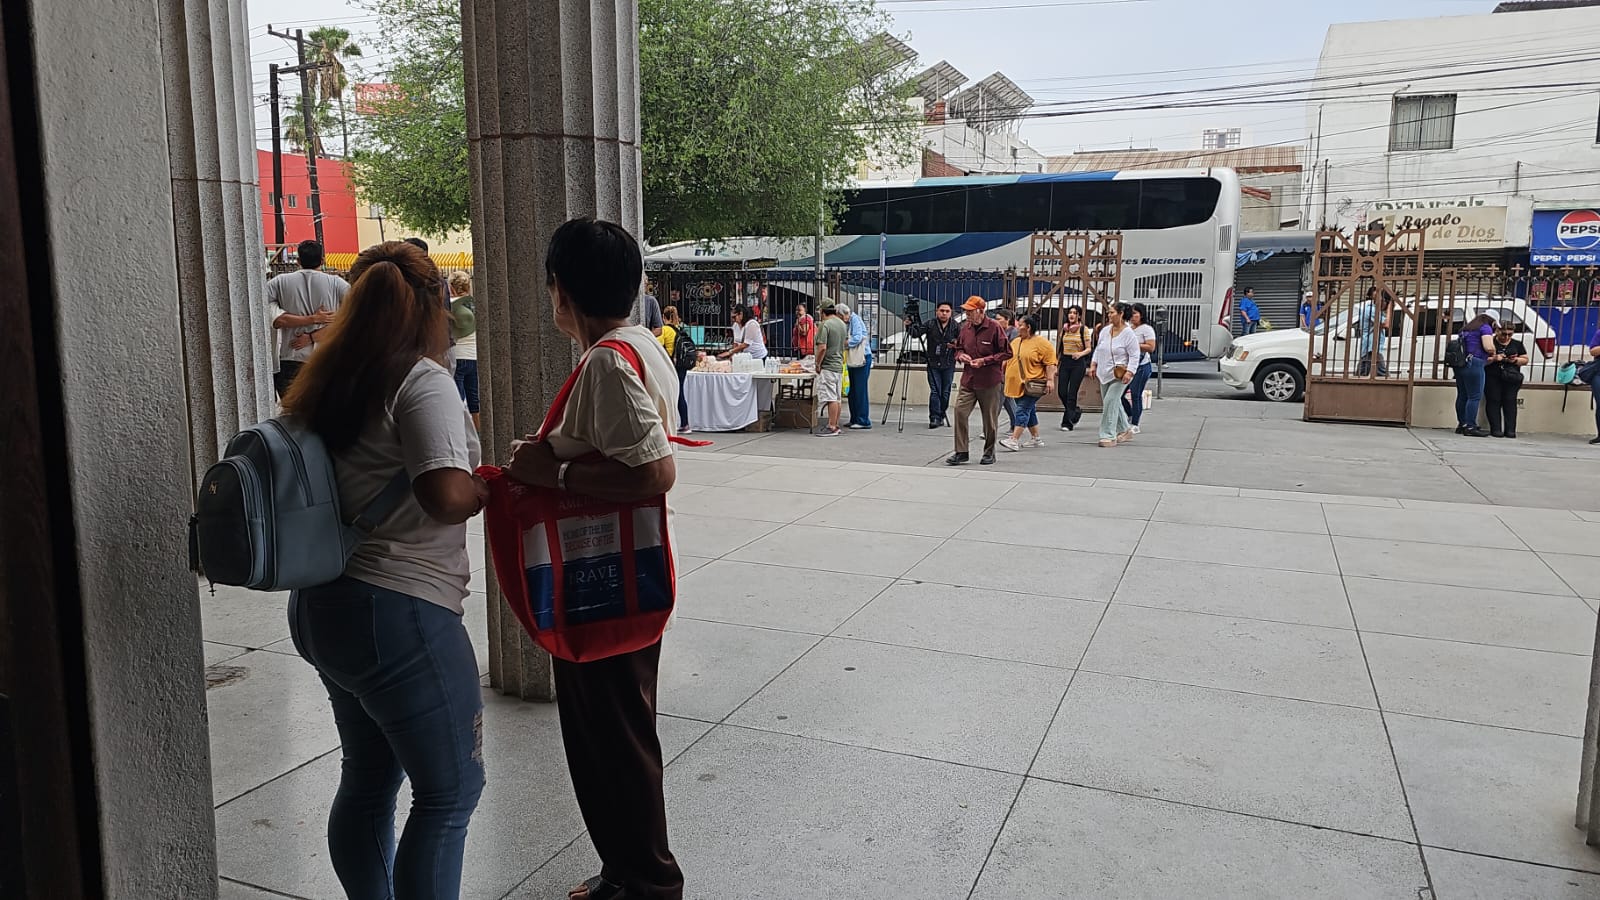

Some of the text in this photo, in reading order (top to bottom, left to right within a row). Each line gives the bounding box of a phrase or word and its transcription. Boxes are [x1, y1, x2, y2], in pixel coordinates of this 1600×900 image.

[1402, 214, 1461, 229] Regalo
[1432, 225, 1496, 239] de Dios
[1141, 257, 1206, 265] Nacionales
[1533, 254, 1596, 262] PEPSI PEPSI
